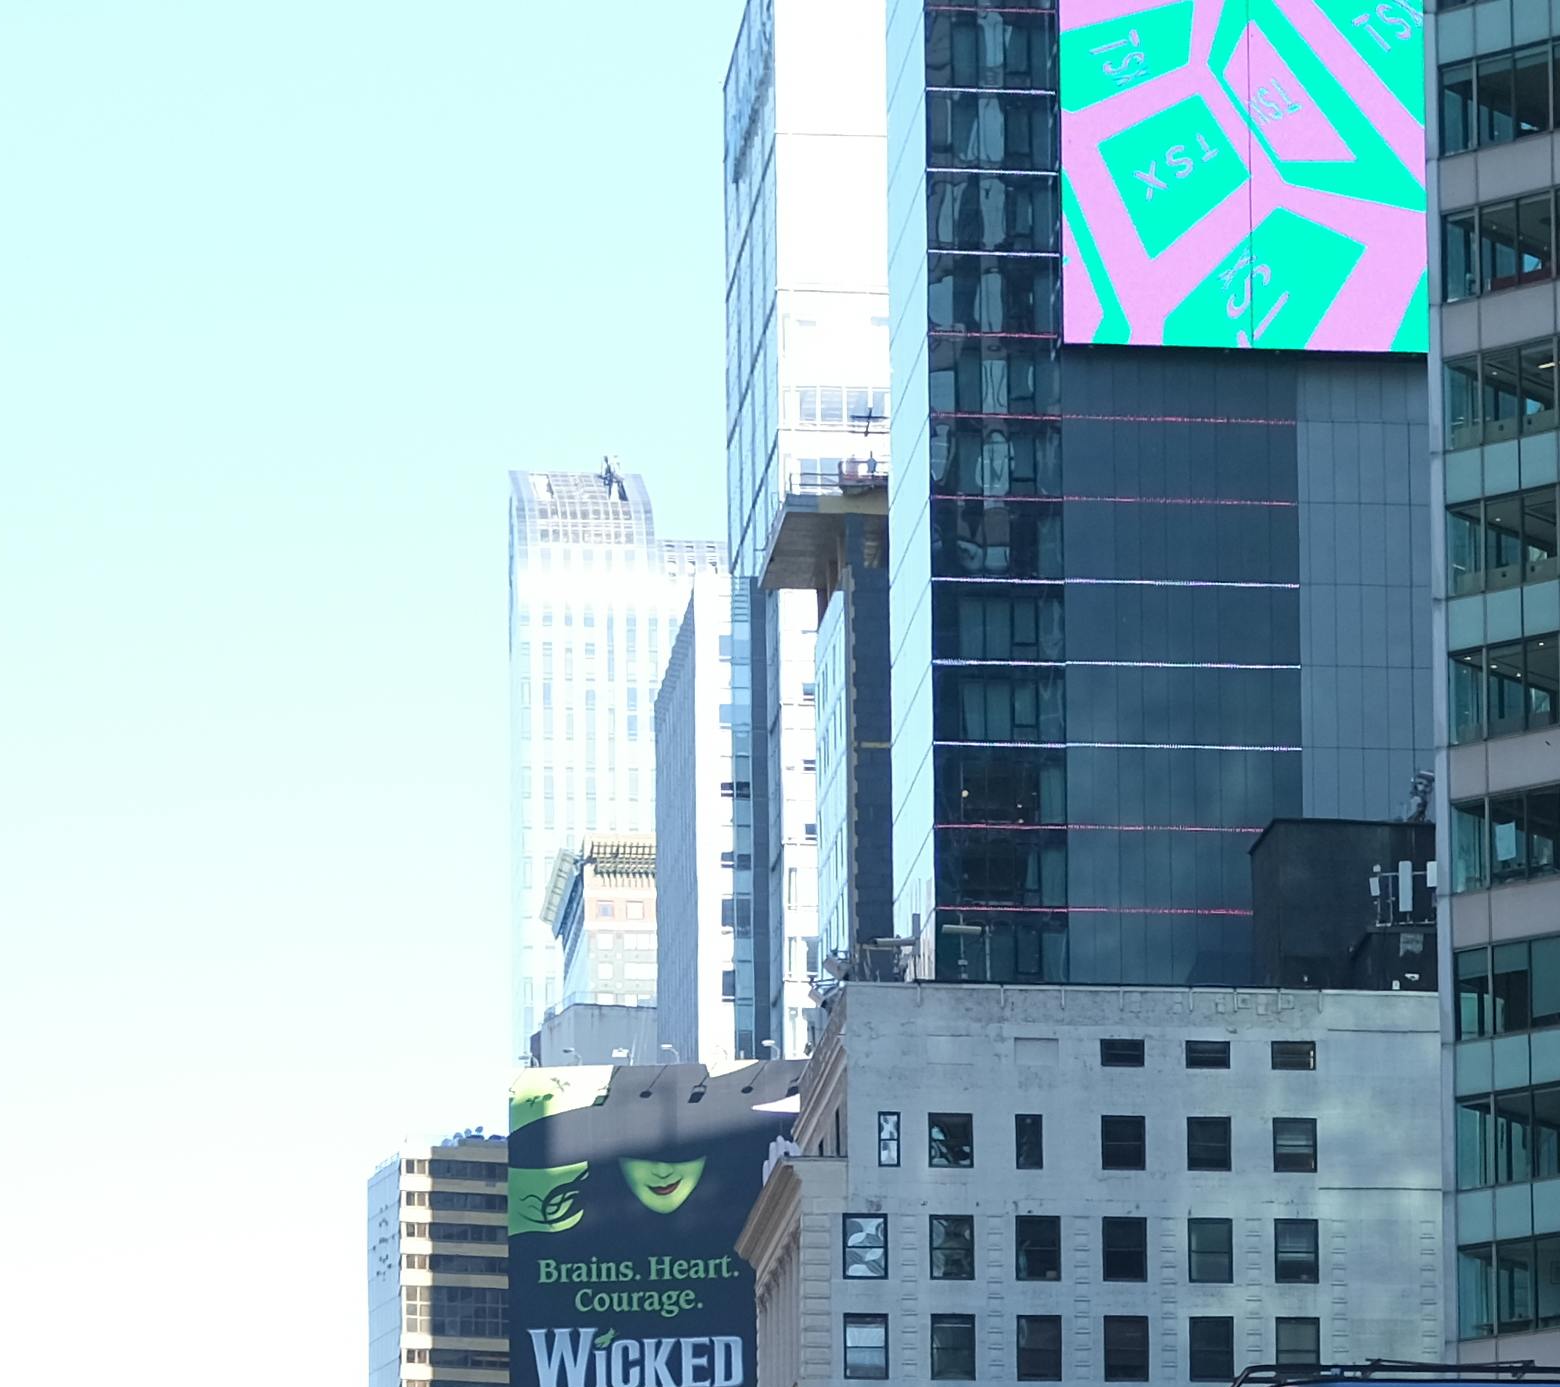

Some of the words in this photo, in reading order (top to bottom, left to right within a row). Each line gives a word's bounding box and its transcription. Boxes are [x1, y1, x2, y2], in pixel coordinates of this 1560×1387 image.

[1133, 132, 1220, 202] TSX
[537, 1255, 641, 1285] Brains.
[647, 1254, 740, 1281] Heart.
[574, 1288, 704, 1318] Courage.
